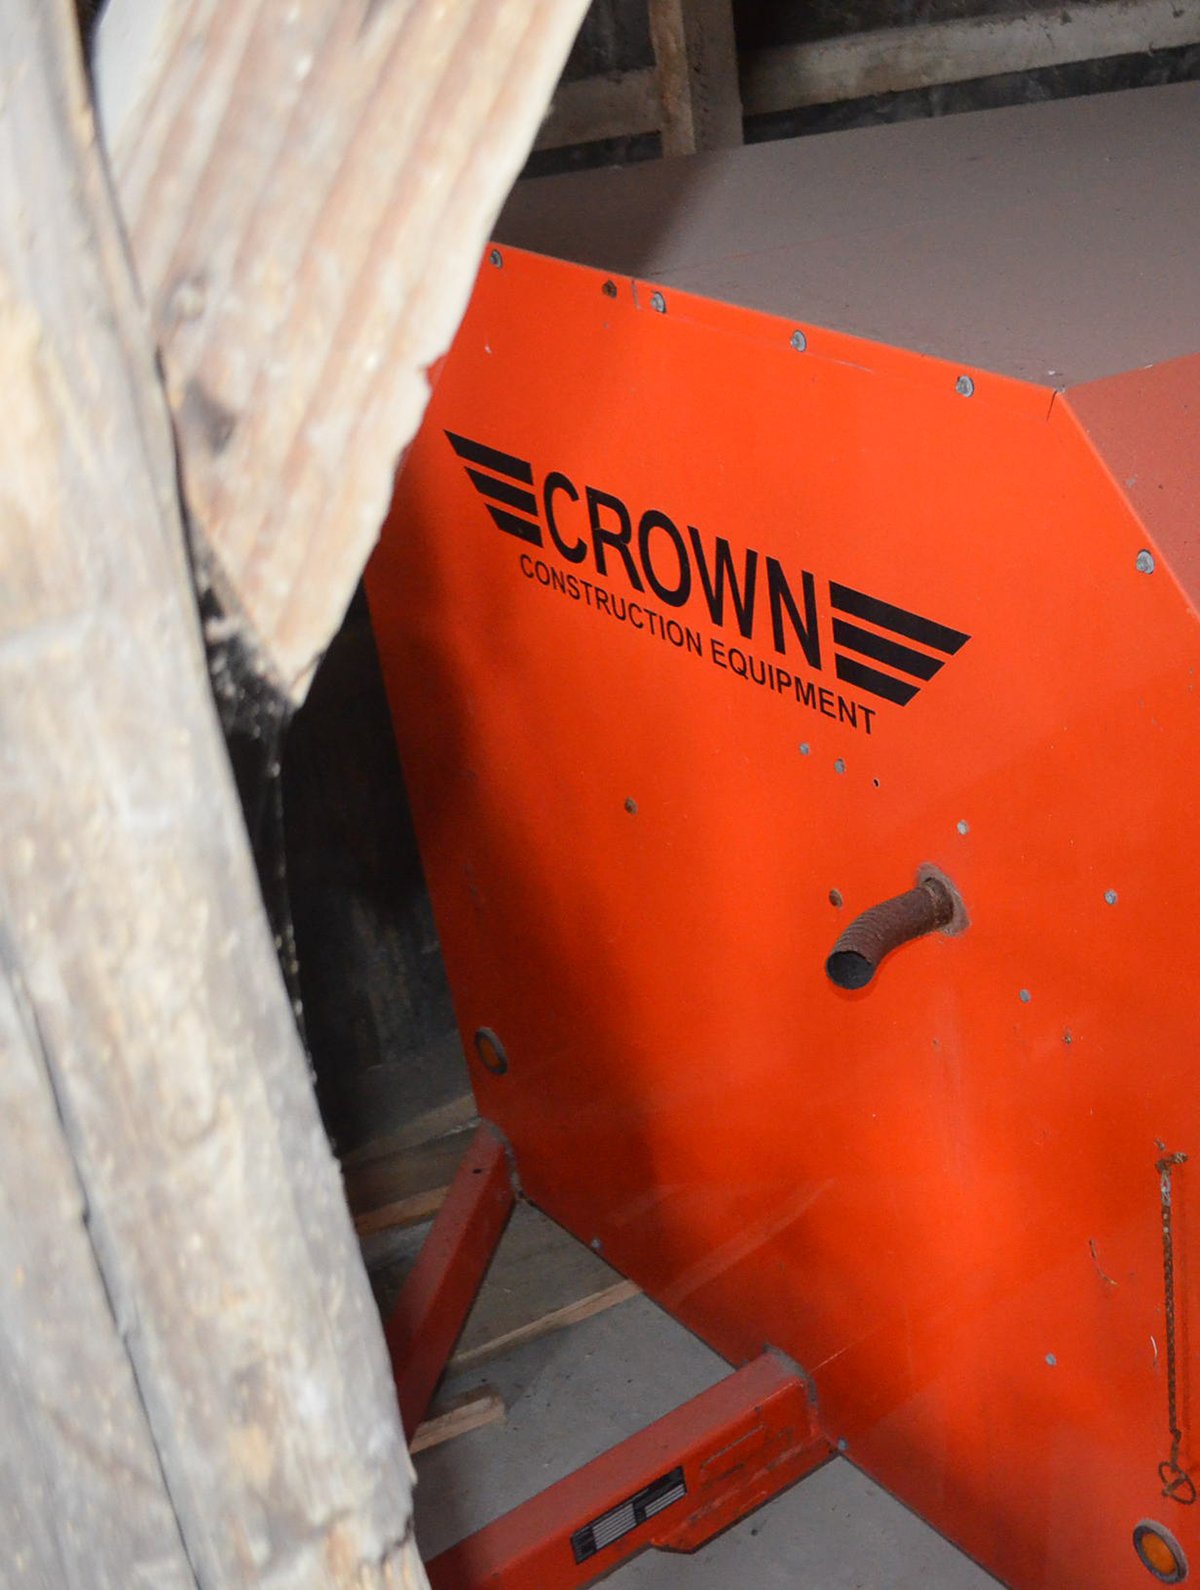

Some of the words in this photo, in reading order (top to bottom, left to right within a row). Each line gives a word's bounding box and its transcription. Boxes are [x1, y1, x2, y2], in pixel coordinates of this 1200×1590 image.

[519, 553, 702, 655] CONSTRUCTION
[710, 640, 877, 735] EQUIPMENT
[543, 471, 822, 670] CROWN
